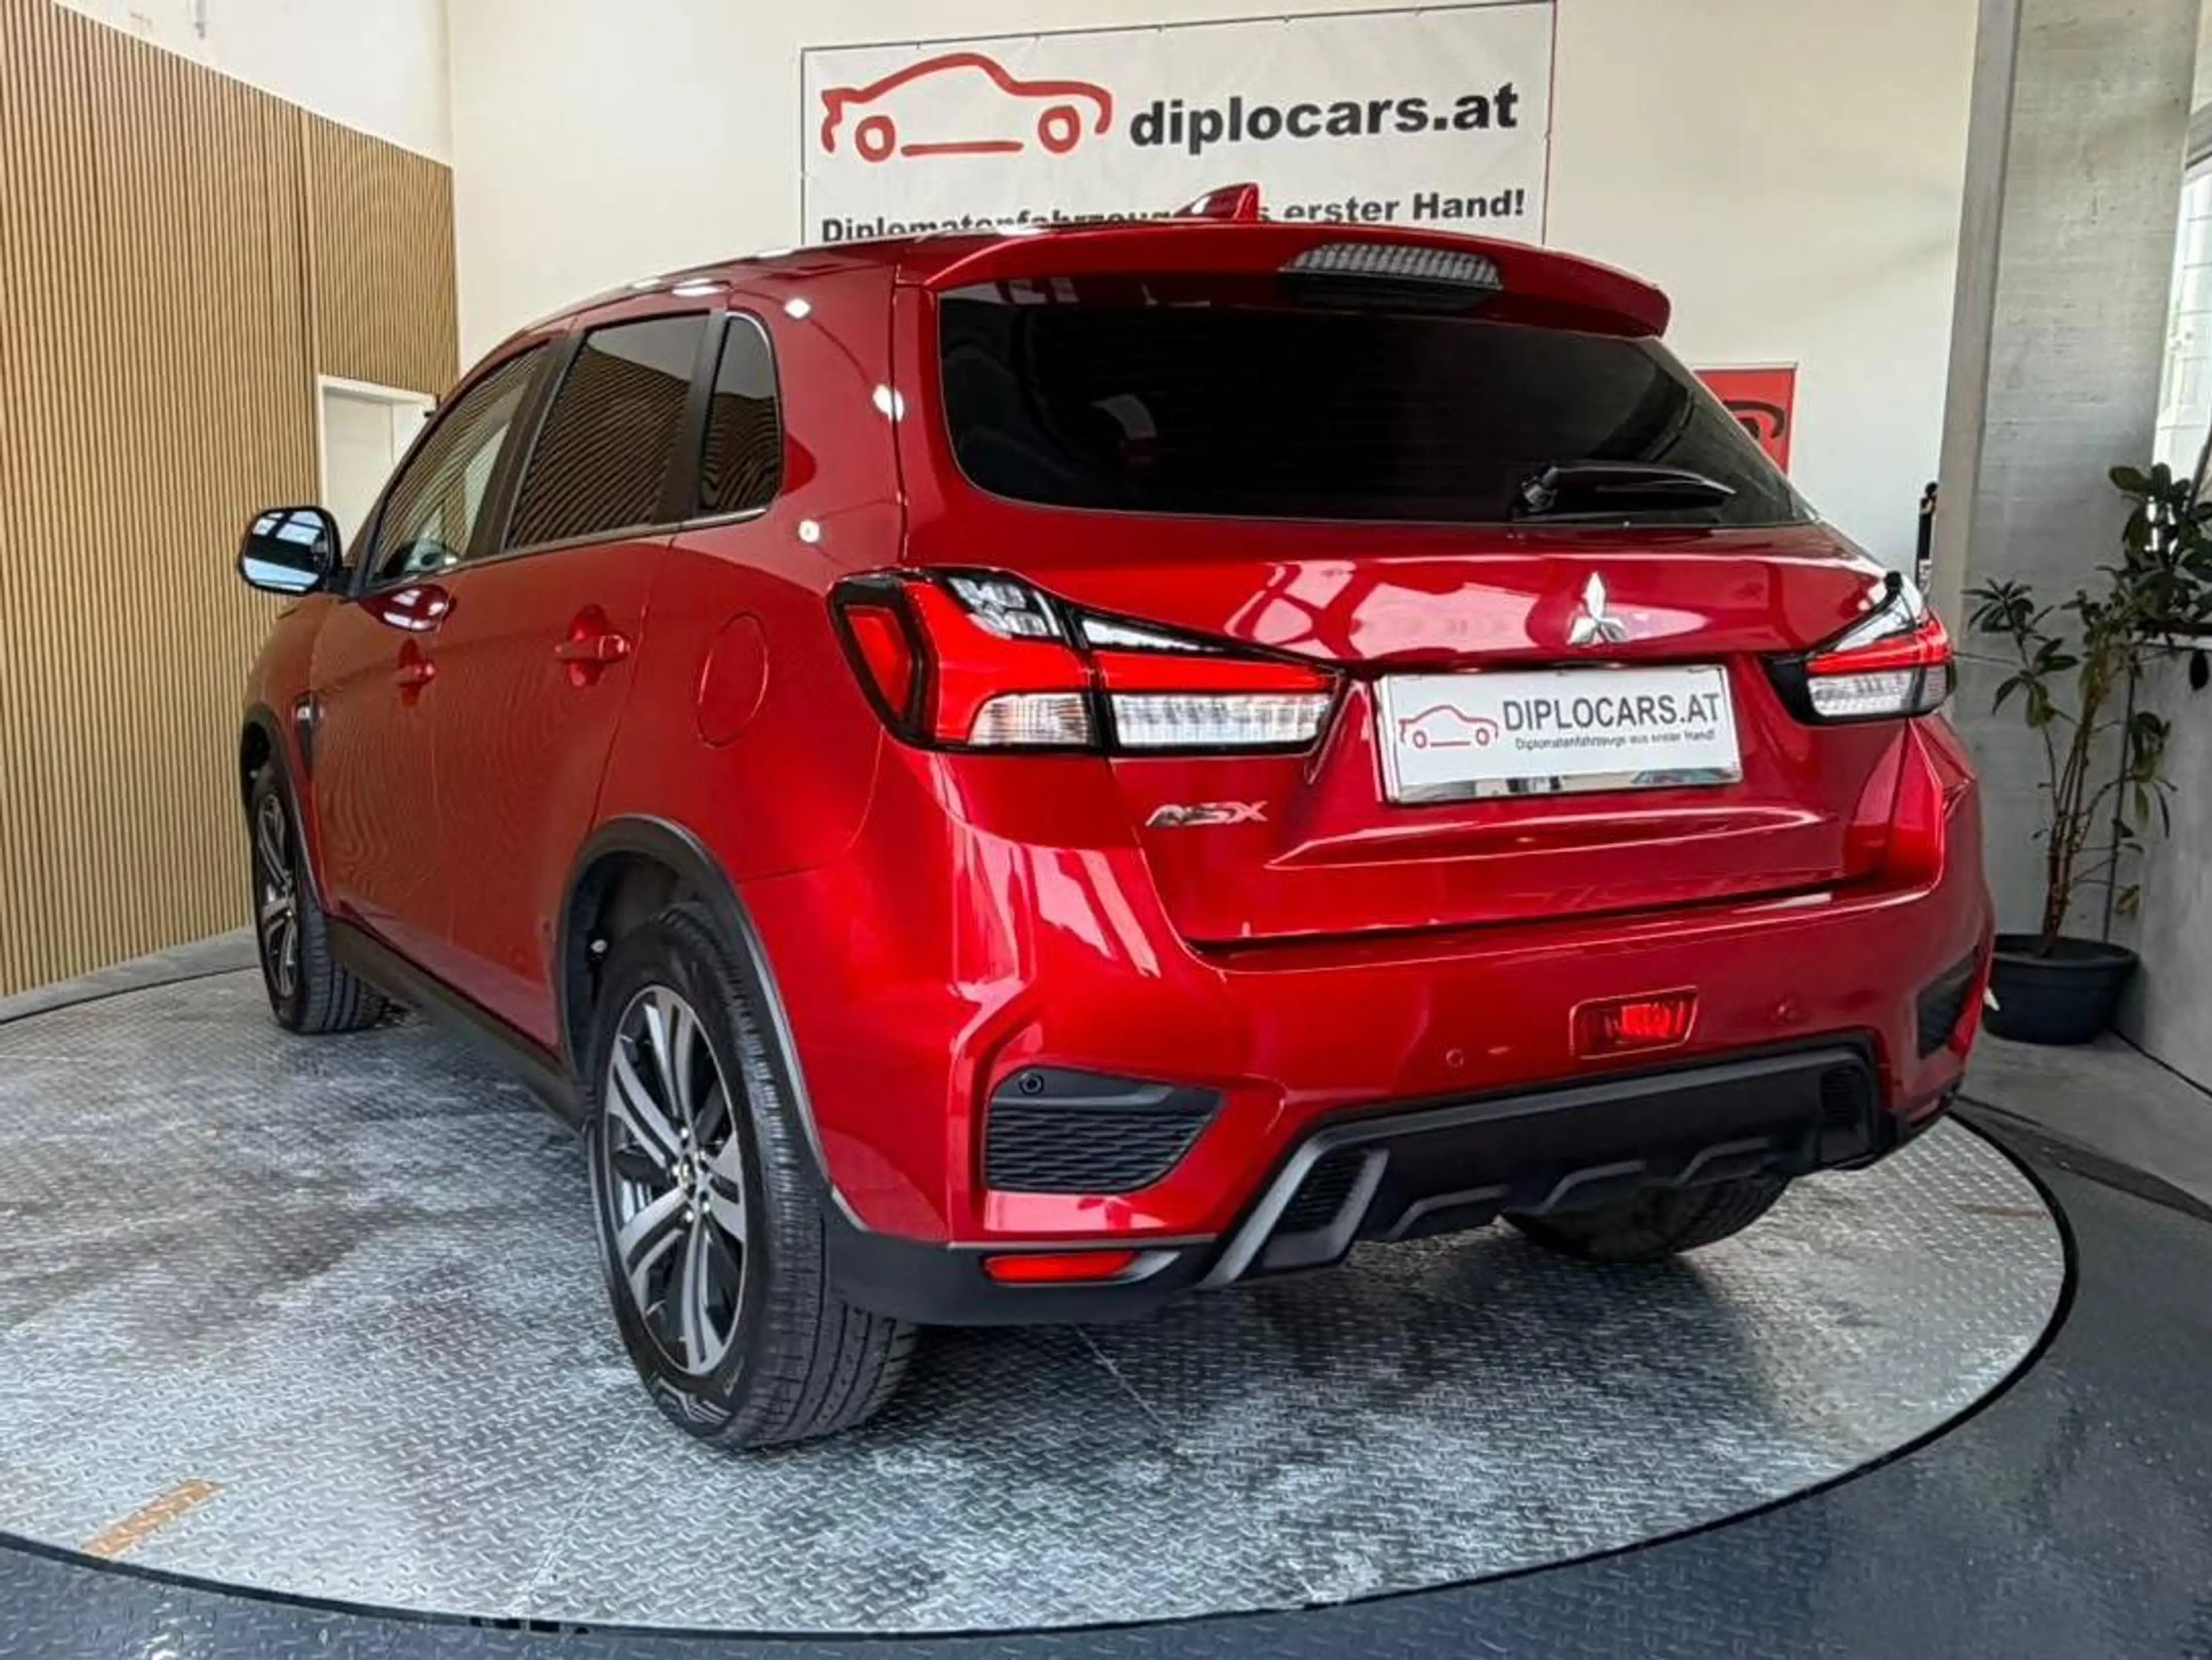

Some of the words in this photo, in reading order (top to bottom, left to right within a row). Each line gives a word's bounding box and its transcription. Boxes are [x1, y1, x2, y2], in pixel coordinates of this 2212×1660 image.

[1130, 82, 1517, 155] diplocars.at
[1284, 198, 1399, 223] erster
[1412, 190, 1525, 220] Hand!
[1503, 693, 1720, 731] DIPLOCARS.AT
